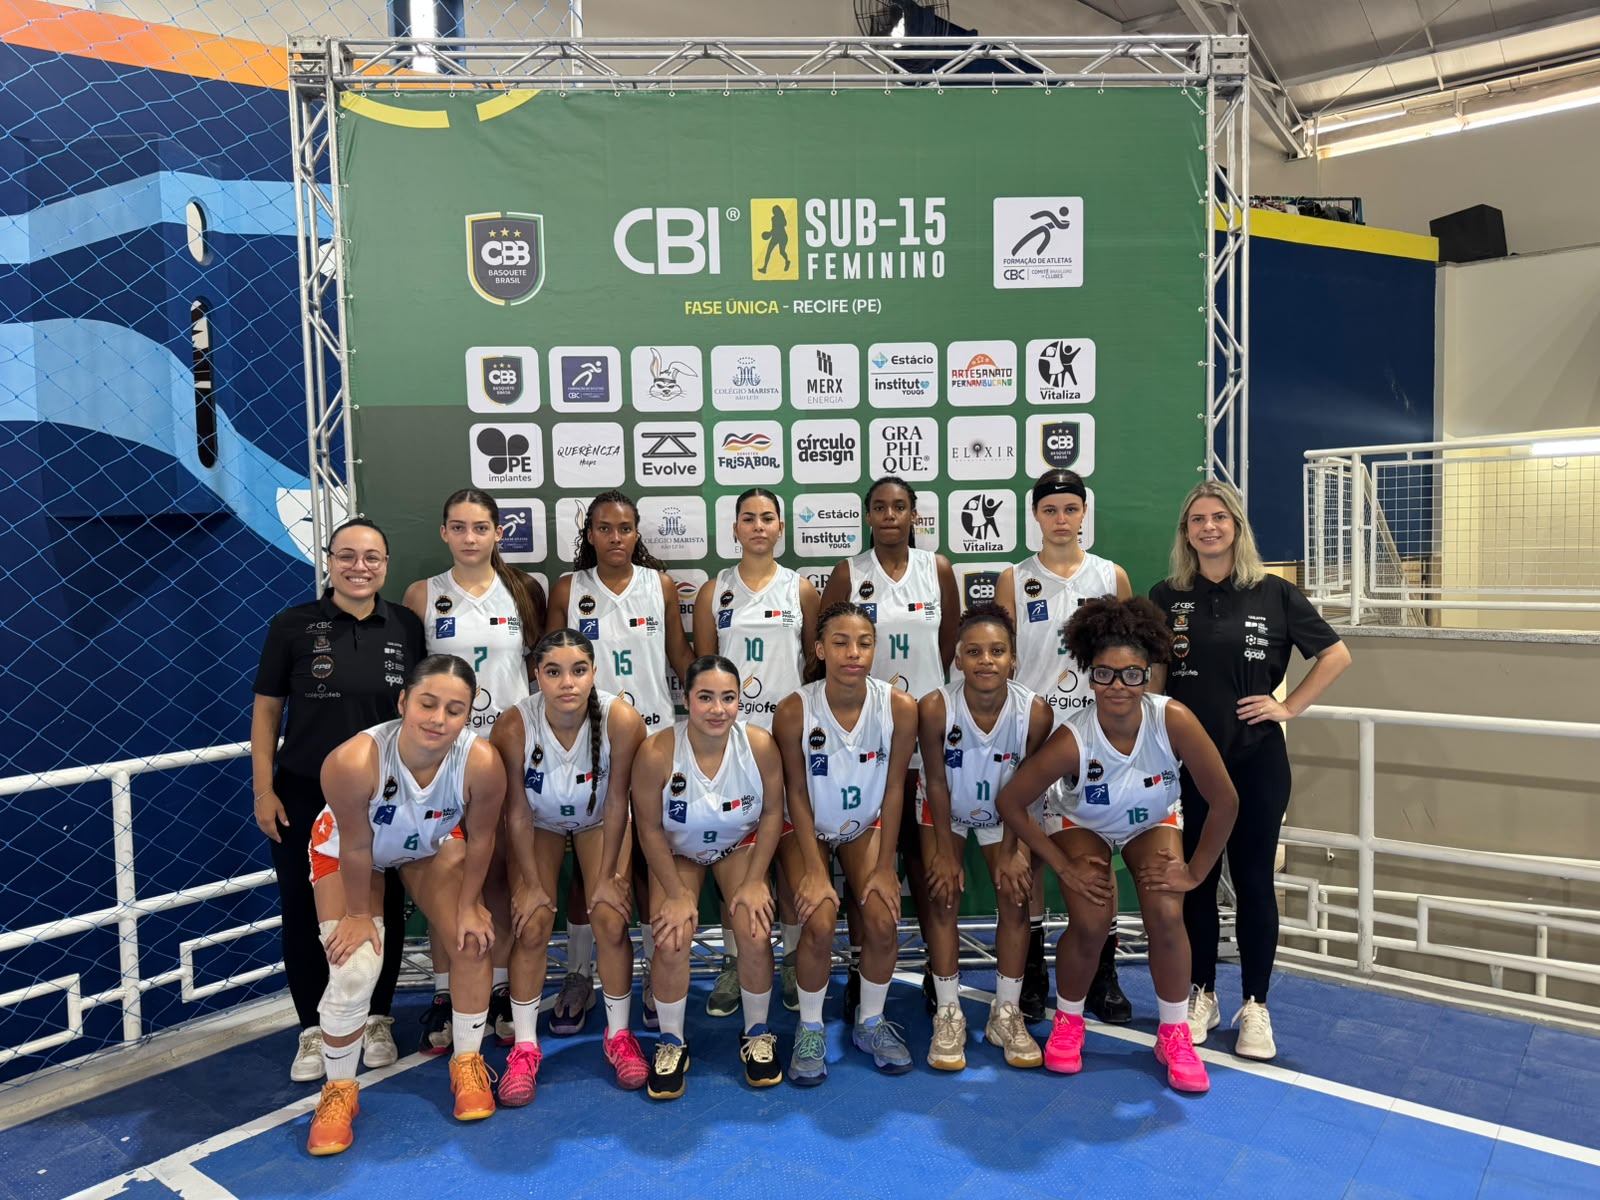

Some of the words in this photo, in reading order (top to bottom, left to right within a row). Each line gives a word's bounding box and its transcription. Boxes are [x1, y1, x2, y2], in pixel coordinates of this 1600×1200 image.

[805, 197, 946, 247] SUB-15
[481, 241, 531, 266] CBB
[1003, 257, 1037, 265] FORMAÇÃO
[808, 250, 945, 280] FEMININO
[488, 269, 527, 277] BASQUETE
[495, 276, 521, 284] BRASIL
[1003, 269, 1025, 281] CBC
[685, 300, 723, 315] FASE
[725, 298, 780, 315] ÚNICA
[793, 299, 848, 314] RECIFE
[852, 298, 882, 314] (PE)
[891, 355, 934, 366] Estácio
[488, 369, 517, 385] CBB
[952, 368, 1012, 379] ARTESANATO
[807, 378, 843, 395] MERX
[952, 378, 1012, 388] PERNAMBUCANO
[807, 394, 844, 404] ENERGIA
[1040, 390, 1081, 400] Vitaliza
[882, 426, 922, 441] GRA
[797, 433, 856, 450] círculo
[886, 442, 920, 456] PHI
[1047, 435, 1074, 450] CBB
[557, 444, 621, 458] QUERÊNCIA
[798, 448, 854, 466] design
[509, 456, 532, 473] PE
[642, 462, 697, 476] Evolve
[489, 473, 532, 483] implantes
[818, 509, 860, 520] Estácio
[963, 541, 1004, 552] Vitaliza
[316, 621, 332, 629] CBC
[745, 637, 764, 662] 10
[889, 634, 909, 659] 14
[474, 646, 487, 672] 7
[612, 650, 632, 676] 15
[841, 786, 861, 810] 13
[976, 780, 990, 801] 11
[560, 805, 576, 816] 8
[1127, 807, 1149, 825] 16
[403, 833, 420, 851] 6
[703, 830, 718, 843] 9
